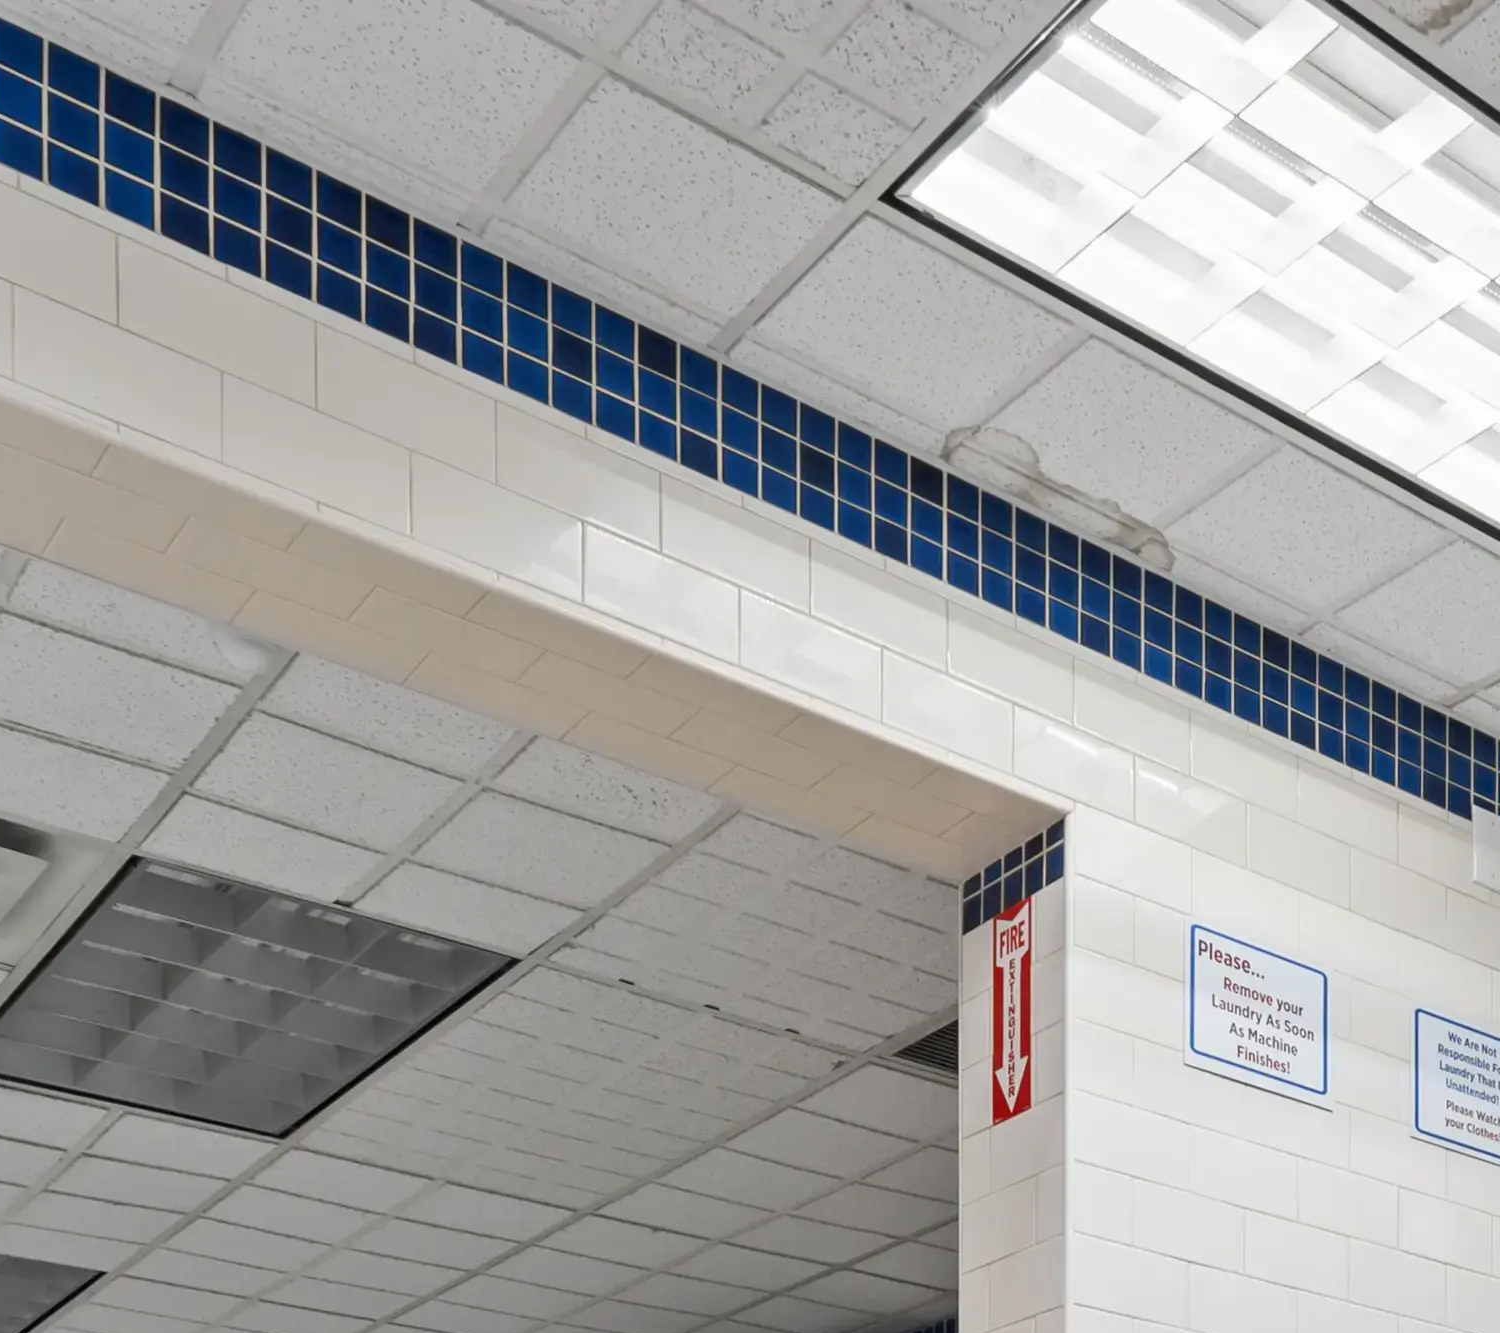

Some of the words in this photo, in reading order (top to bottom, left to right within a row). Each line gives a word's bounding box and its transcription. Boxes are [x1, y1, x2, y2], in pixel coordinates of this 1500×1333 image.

[1000, 919, 1025, 959] FIRE
[1198, 939, 1265, 979] Please...
[1223, 977, 1273, 1006] Remove
[1276, 997, 1304, 1017] your
[1008, 958, 1016, 1099] EXTINGUISHER
[1212, 993, 1263, 1025] Laundry
[1266, 1014, 1281, 1030] As
[1284, 1020, 1315, 1041] Soon
[1229, 1022, 1245, 1037] As
[1248, 1028, 1298, 1056] Machine
[1448, 1031, 1462, 1045] We
[1464, 1040, 1480, 1051] Are
[1481, 1044, 1497, 1058] Not
[1237, 1045, 1291, 1074] Finishes!
[1438, 1043, 1490, 1071] Responsible
[1440, 1060, 1475, 1082] Laundry
[1477, 1073, 1495, 1087] That
[1445, 1077, 1500, 1105] Unattended!
[1445, 1117, 1464, 1129] your
[1446, 1100, 1474, 1118] Please
